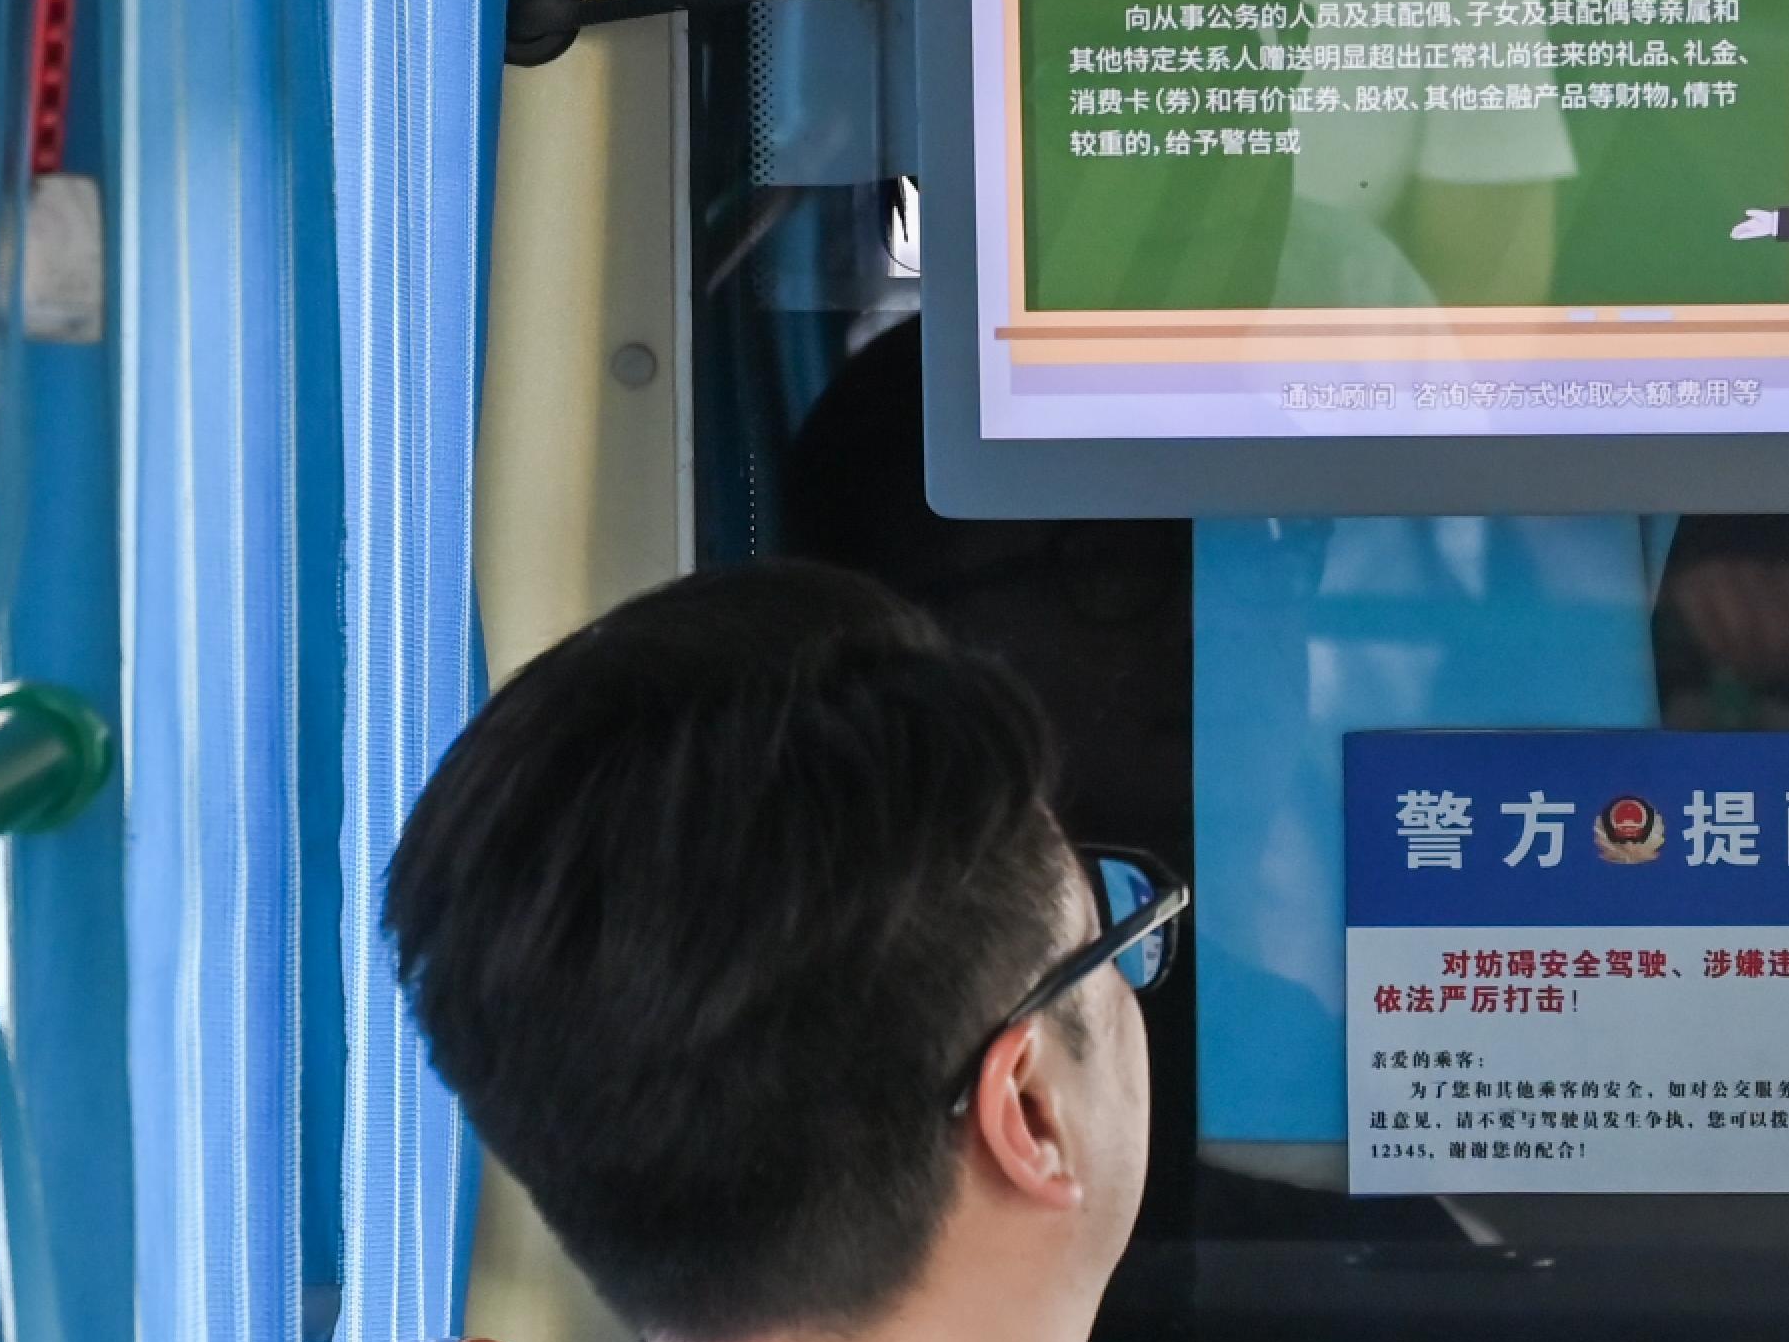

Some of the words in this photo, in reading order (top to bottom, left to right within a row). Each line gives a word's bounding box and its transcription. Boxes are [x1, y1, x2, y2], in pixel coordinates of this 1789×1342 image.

[1069, 39, 1749, 73] 其他特定关系人赠送明显超出正常礼尚往来的礼品、礼金、
[1280, 382, 1396, 410] 通过顾问
[1412, 378, 1761, 409] 咨询等方式收取大额费用等
[1395, 789, 1576, 869] 警方
[1374, 984, 1580, 1014] 依法严厉打击！
